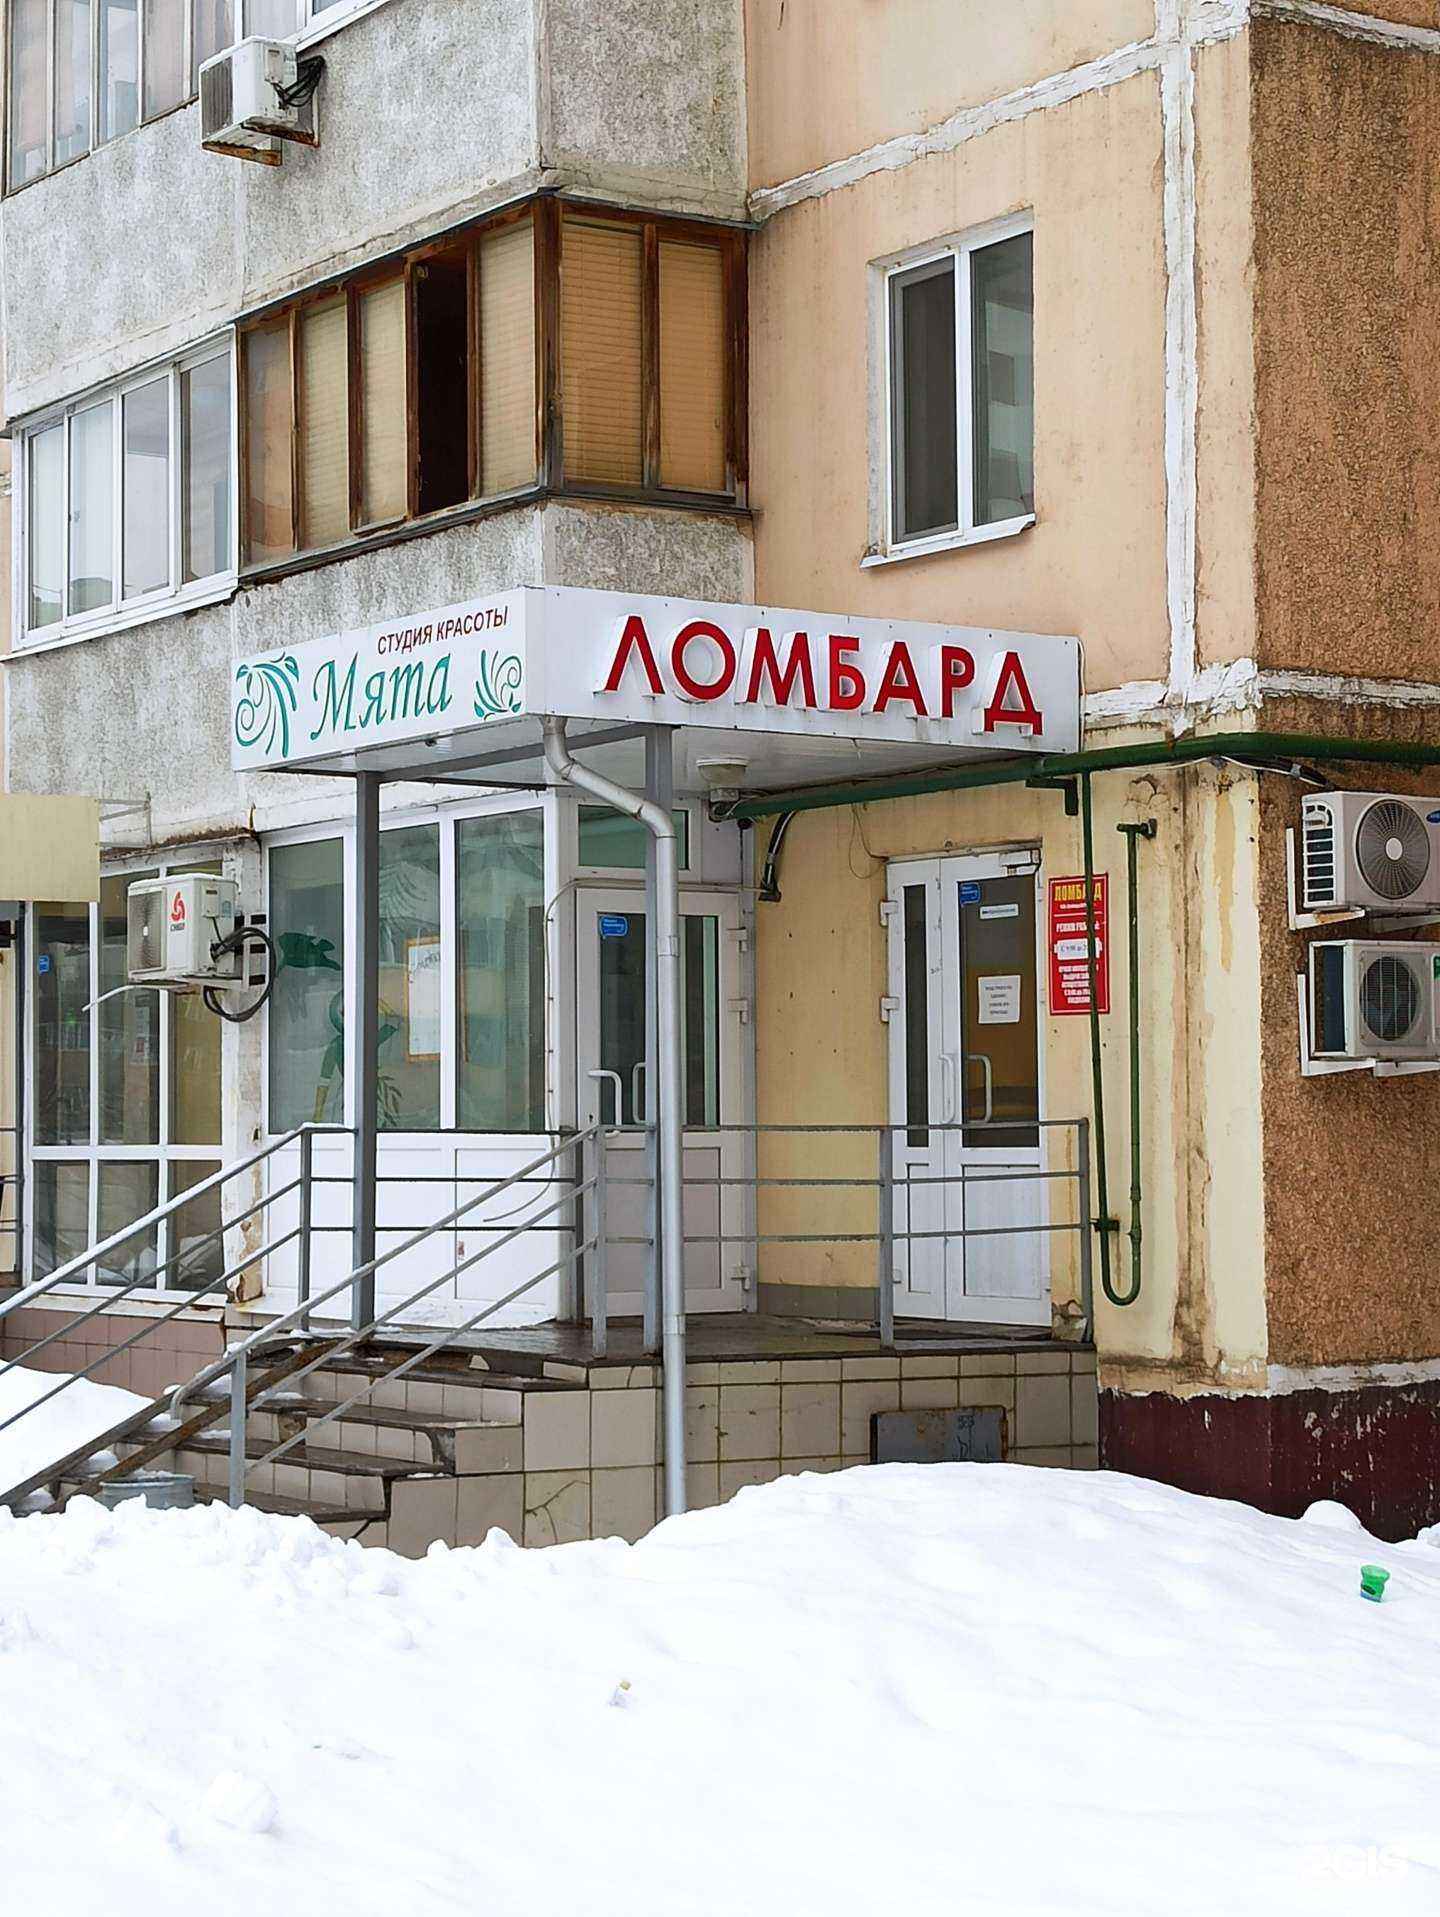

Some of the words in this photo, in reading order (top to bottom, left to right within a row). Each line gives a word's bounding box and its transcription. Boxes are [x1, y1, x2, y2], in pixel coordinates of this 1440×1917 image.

[377, 623, 432, 655] СТУДИЯ
[436, 605, 509, 641] КРАСОТЫ
[310, 650, 453, 742] Мята
[603, 614, 1043, 736] ЛОМБАРД
[1054, 882, 1102, 902] ЛОМБД
